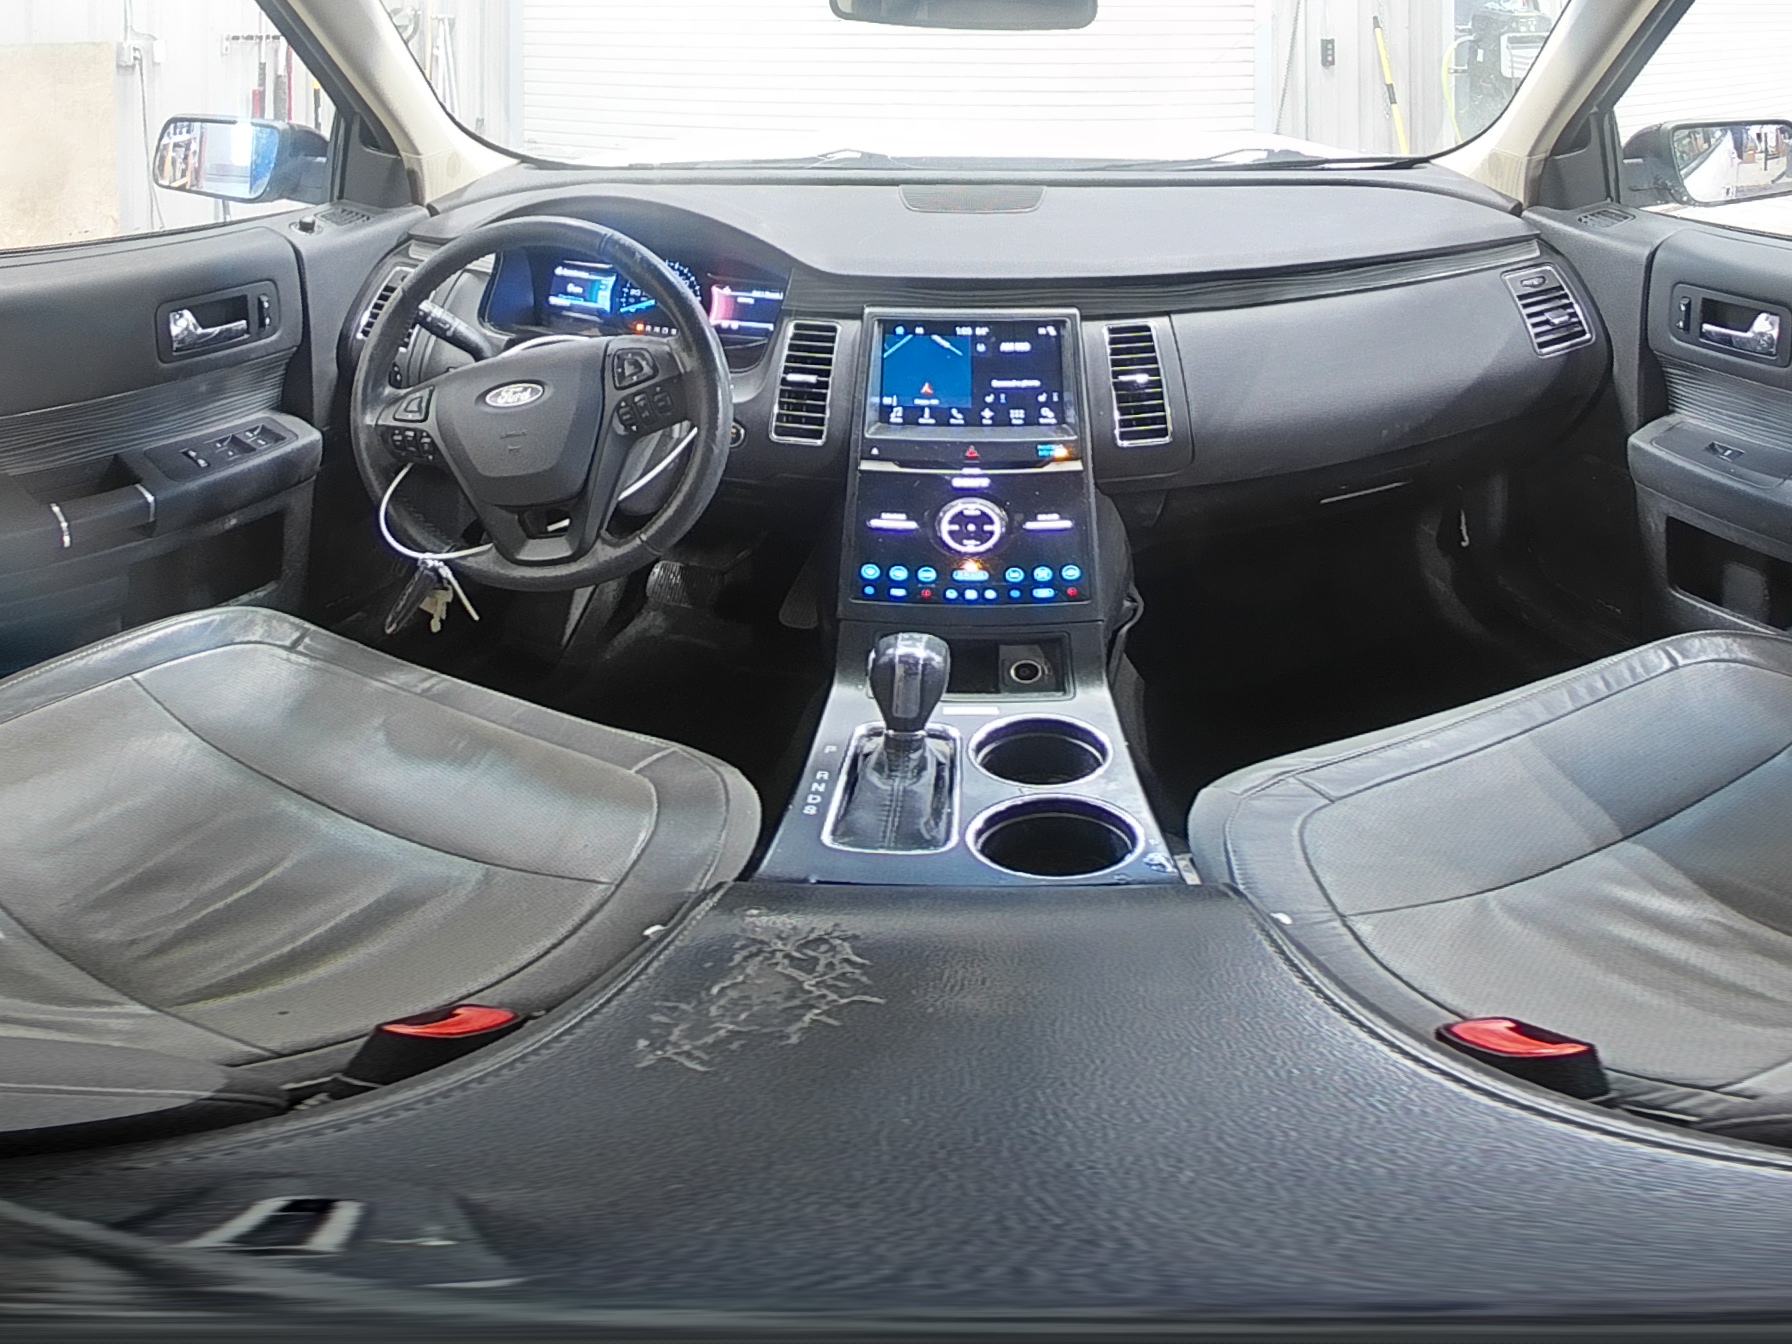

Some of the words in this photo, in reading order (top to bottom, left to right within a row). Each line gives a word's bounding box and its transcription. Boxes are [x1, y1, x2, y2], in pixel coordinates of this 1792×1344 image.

[496, 386, 533, 404] Ford
[824, 745, 837, 753] P
[816, 770, 829, 780] R
[811, 782, 826, 792] N
[806, 794, 821, 803] D
[803, 805, 817, 815] S
